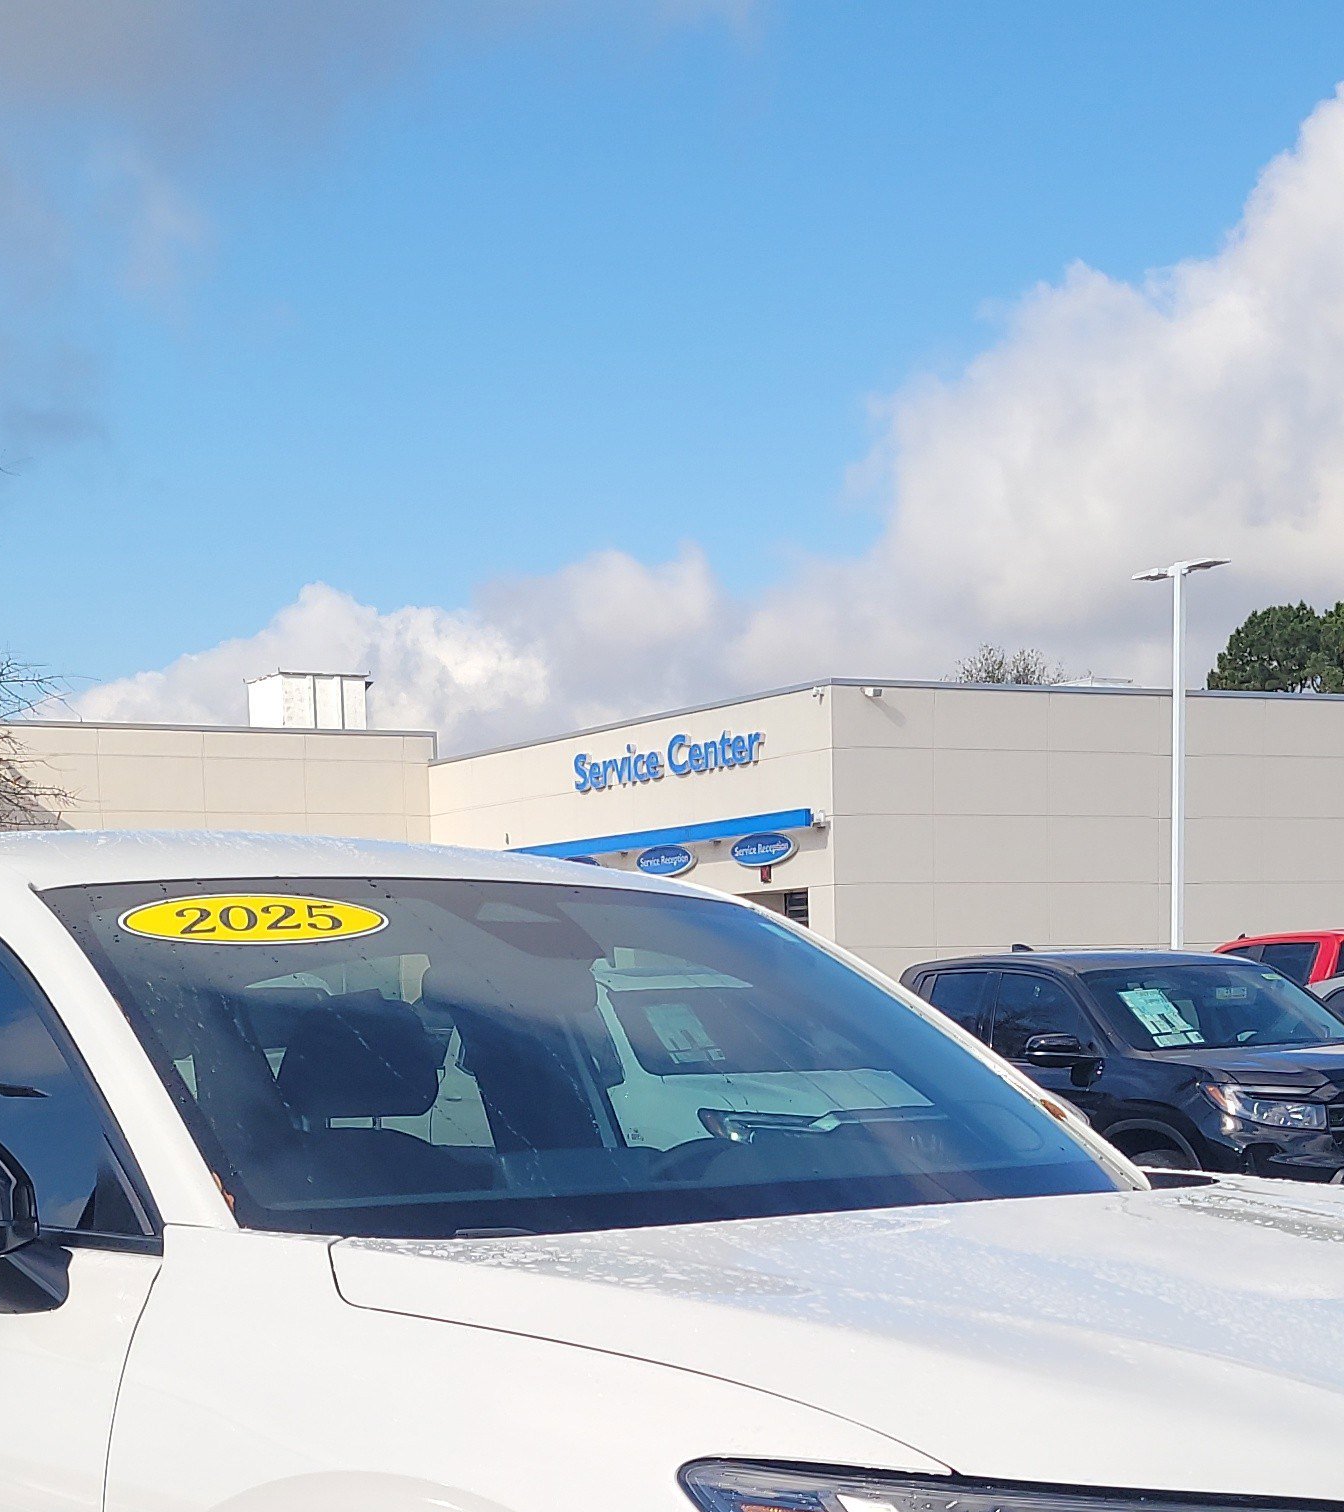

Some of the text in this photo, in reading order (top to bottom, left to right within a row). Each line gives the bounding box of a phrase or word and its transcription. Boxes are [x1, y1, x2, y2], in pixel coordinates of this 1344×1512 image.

[574, 730, 766, 793] Service Center
[639, 856, 660, 867] Service
[734, 844, 757, 857] Service
[175, 904, 343, 935] 2025
